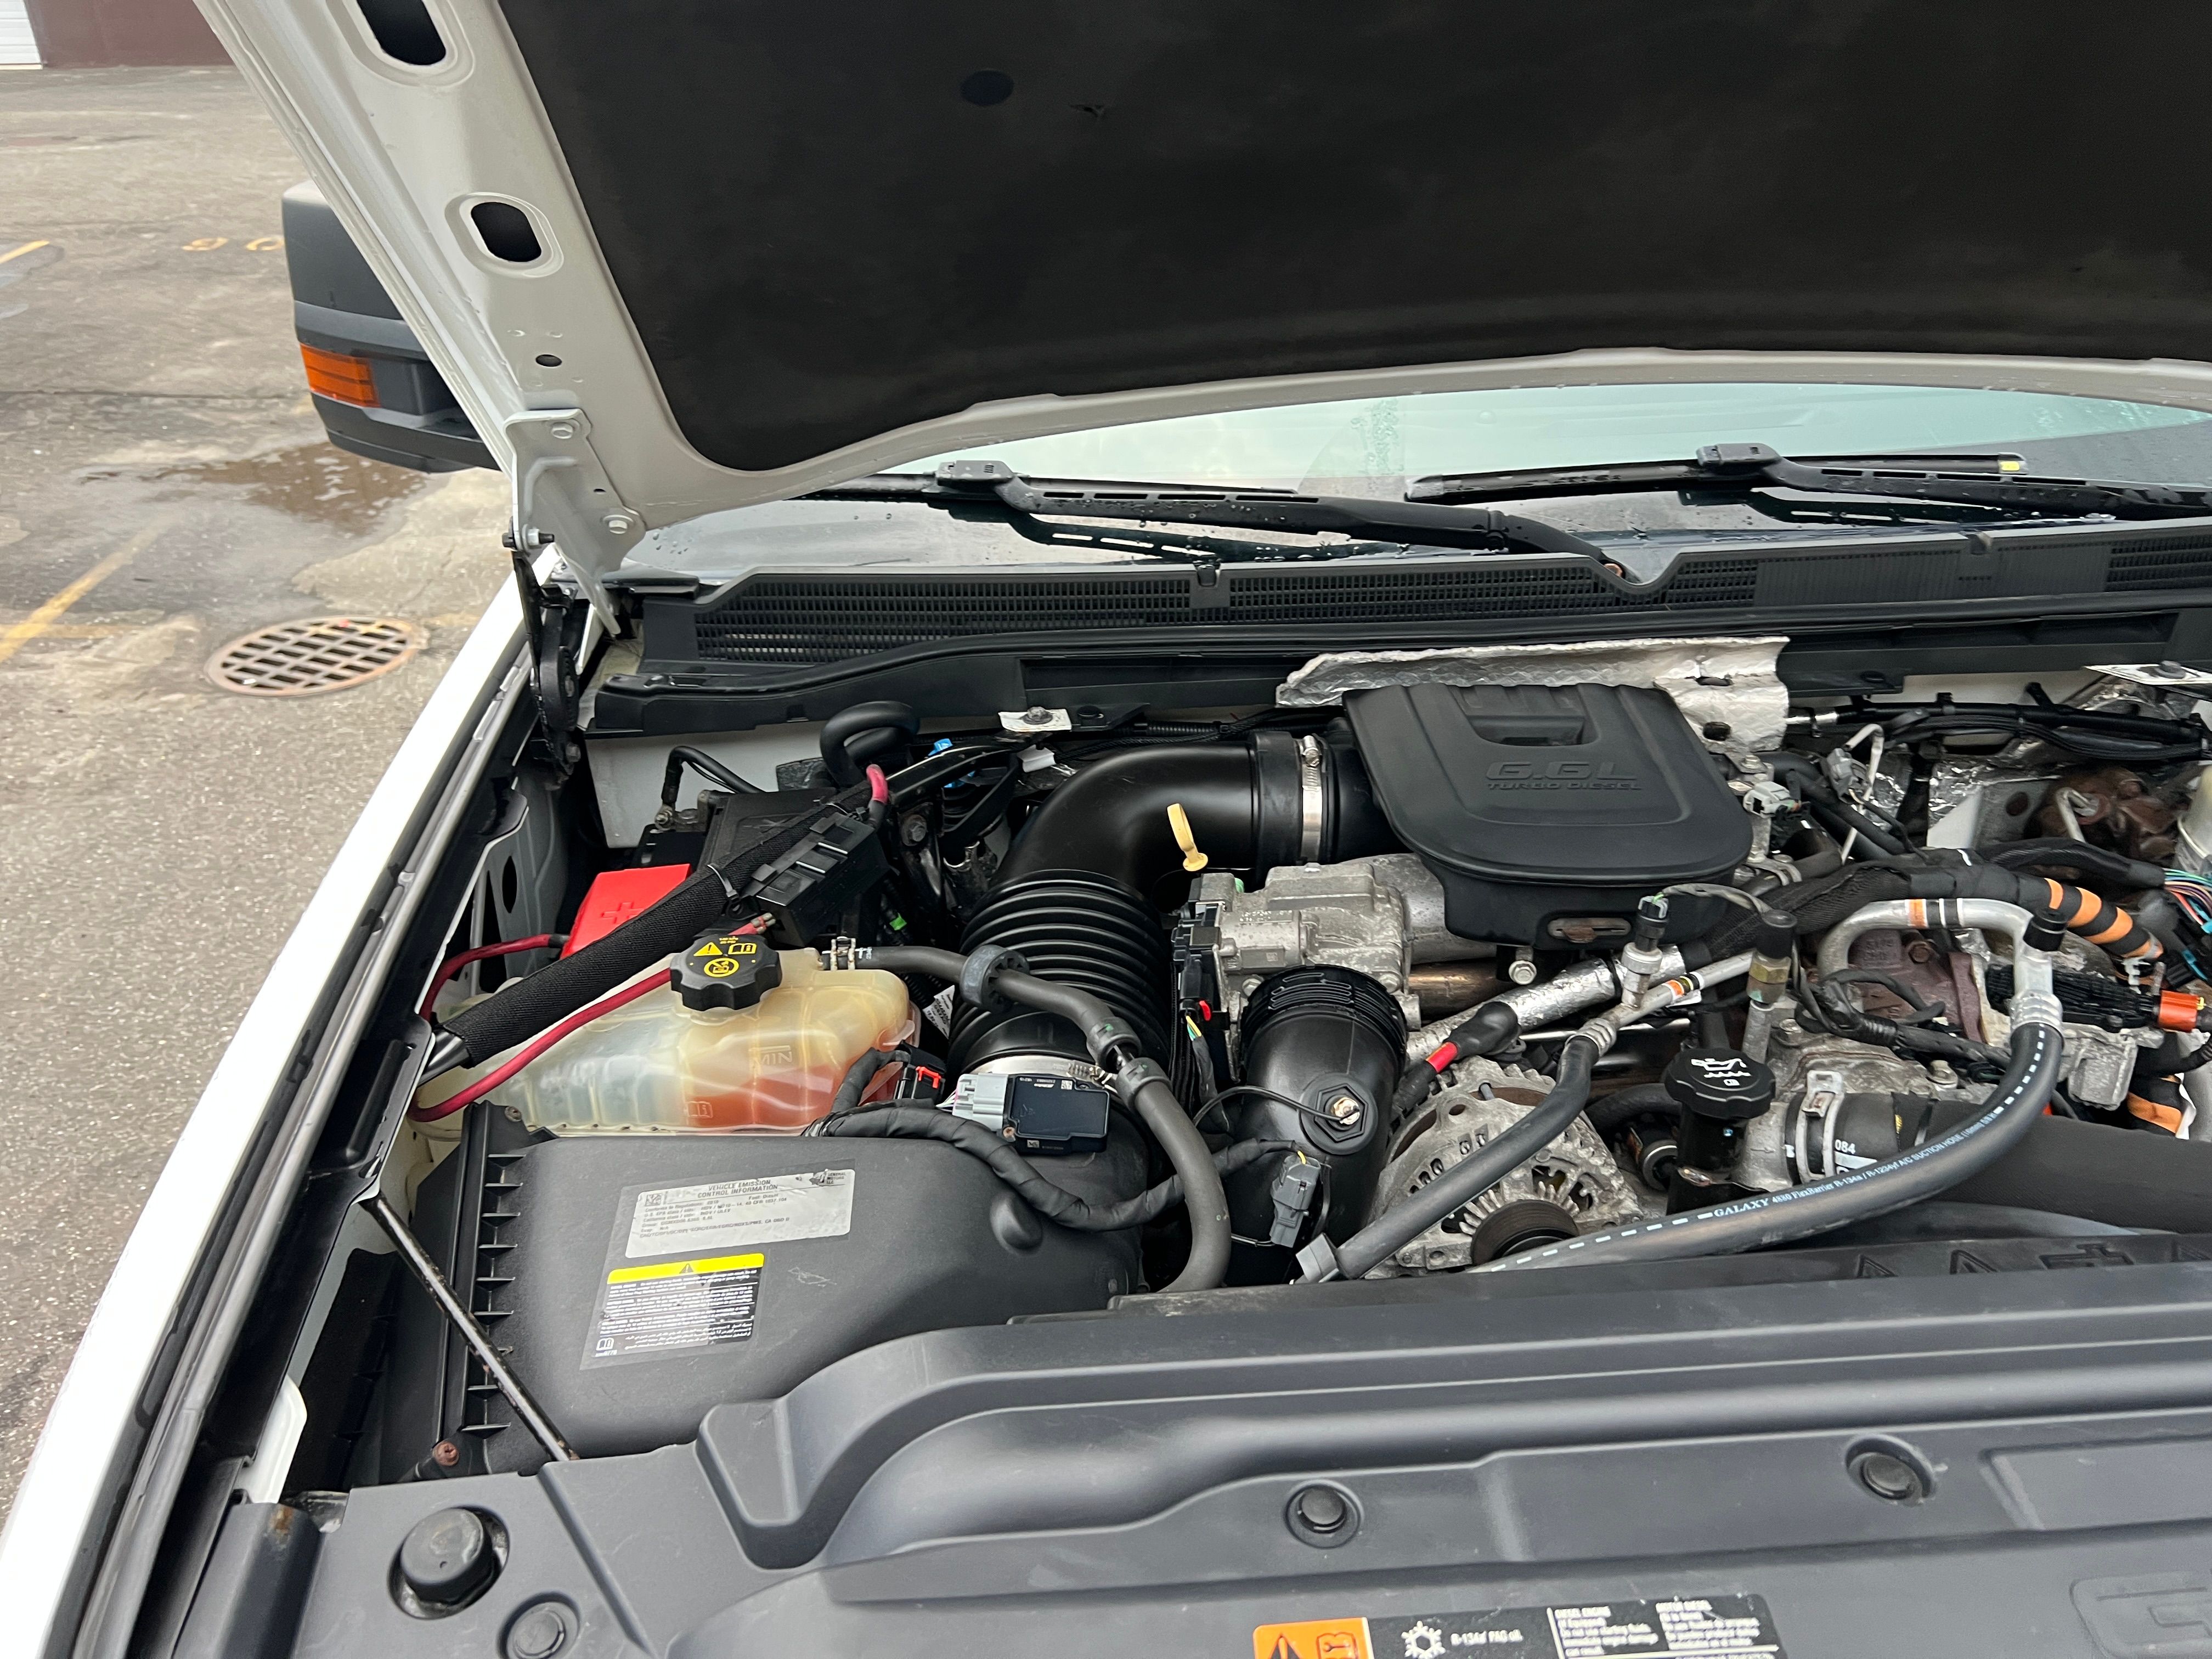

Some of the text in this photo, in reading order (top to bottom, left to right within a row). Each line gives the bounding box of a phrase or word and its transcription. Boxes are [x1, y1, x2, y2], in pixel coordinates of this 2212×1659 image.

[1486, 761, 1637, 781] 6.6L
[1714, 1198, 1769, 1217] GALAXY
[1791, 1183, 1834, 1200] FlexBarrier
[1833, 1173, 1864, 1188] R-134a
[1899, 1156, 1914, 1166] A/C
[1911, 1143, 1945, 1161] SUCTION
[1943, 1133, 1965, 1148] HOSE
[698, 1184, 778, 1199] CONTROL INFORMATION
[708, 1180, 771, 1191] VEHICLE EMISSION
